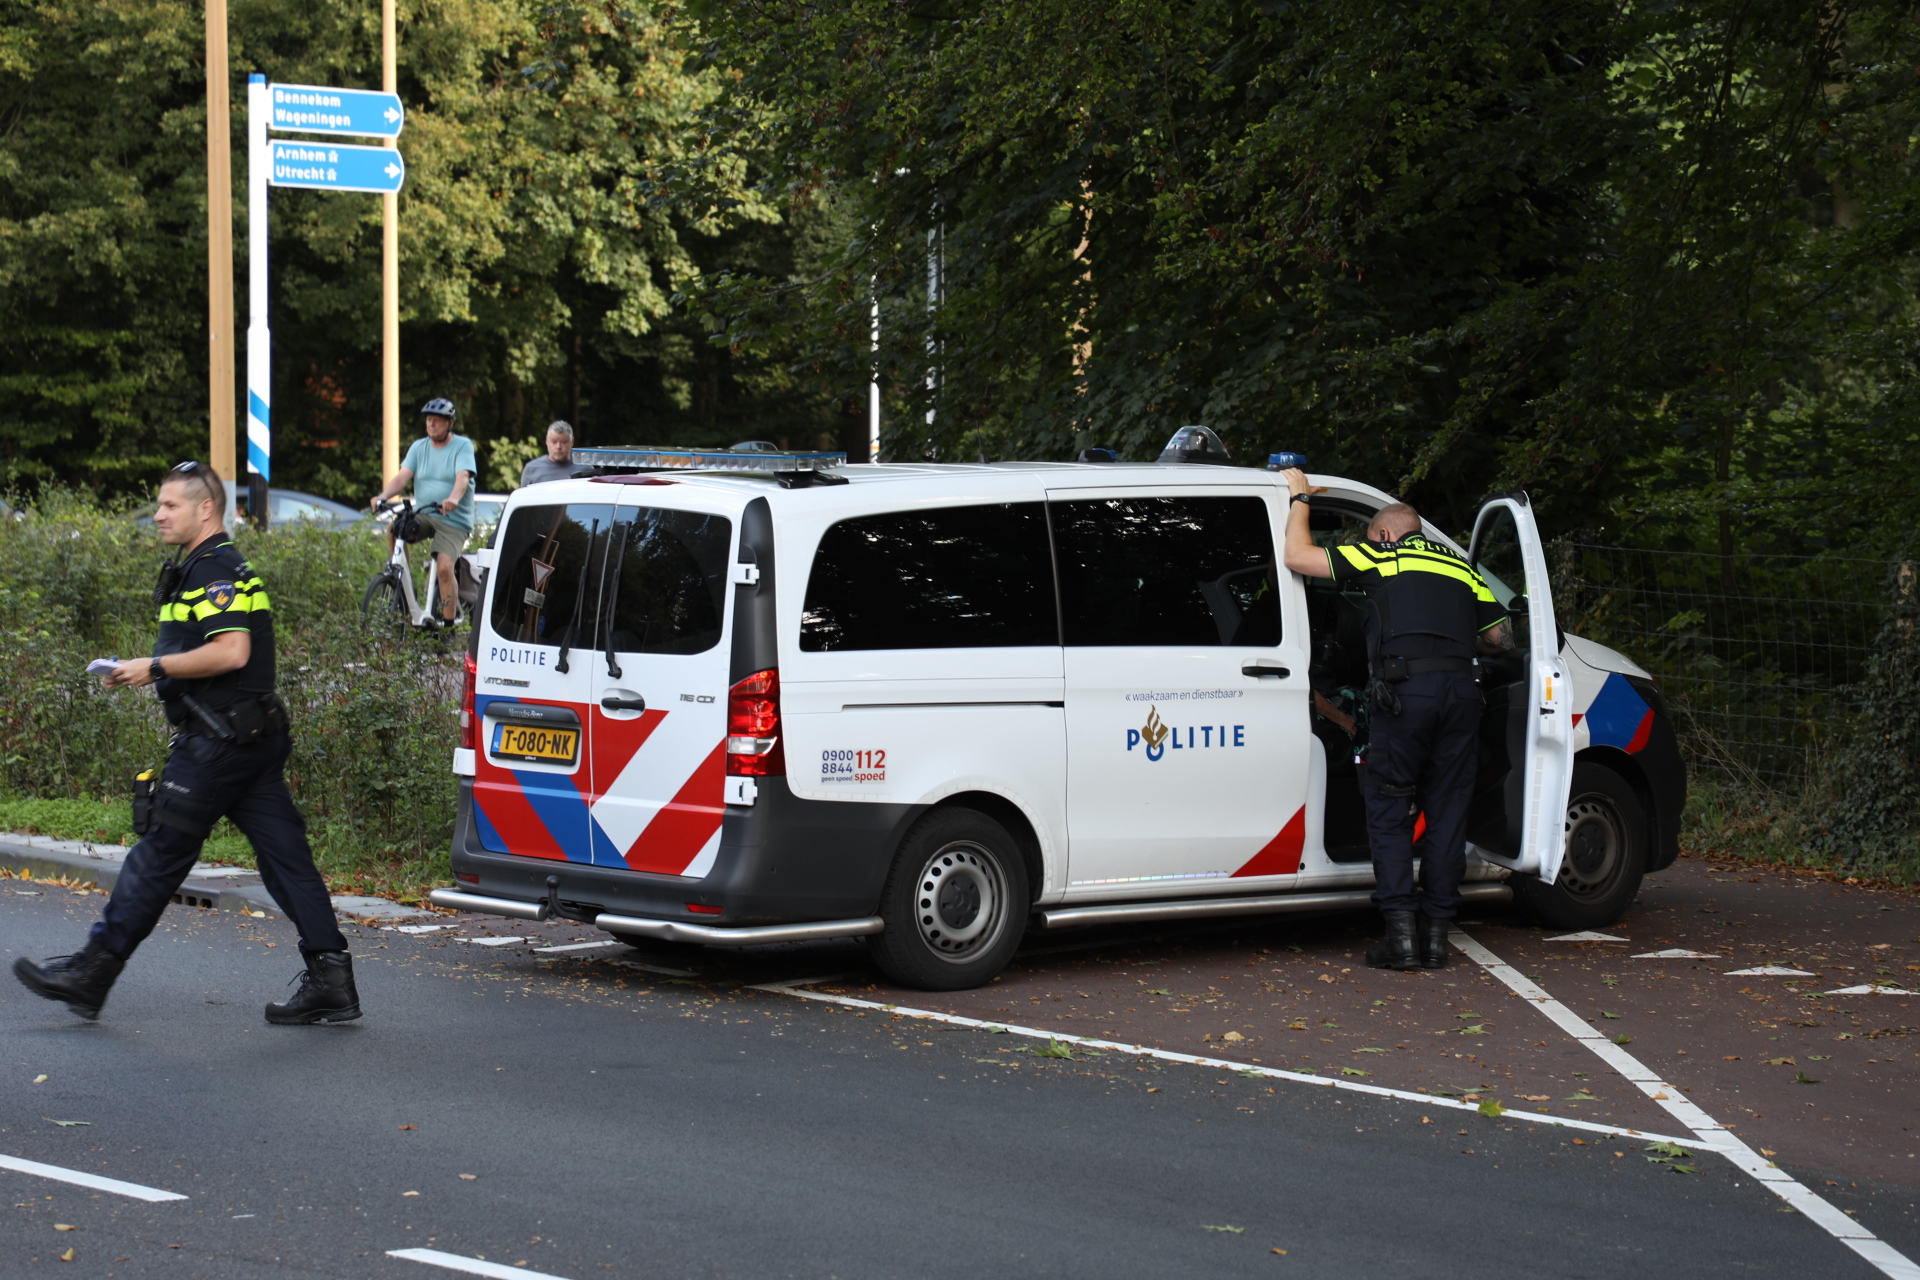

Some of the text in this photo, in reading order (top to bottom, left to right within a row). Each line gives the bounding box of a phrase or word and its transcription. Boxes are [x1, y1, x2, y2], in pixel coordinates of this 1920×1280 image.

[275, 90, 341, 107] Bennekom
[275, 108, 351, 128] Wageningen
[276, 146, 326, 162] Arnhem
[275, 164, 325, 180] Utrecht
[491, 647, 546, 666] POLITIE
[1179, 691, 1191, 700] en
[505, 729, 571, 756] T-080-NK
[1126, 725, 1245, 762] POLITIE
[822, 750, 853, 761] 0900
[855, 749, 886, 769] 112
[821, 762, 853, 774] 8844
[836, 775, 853, 783] spoed
[854, 770, 885, 783] spoed
